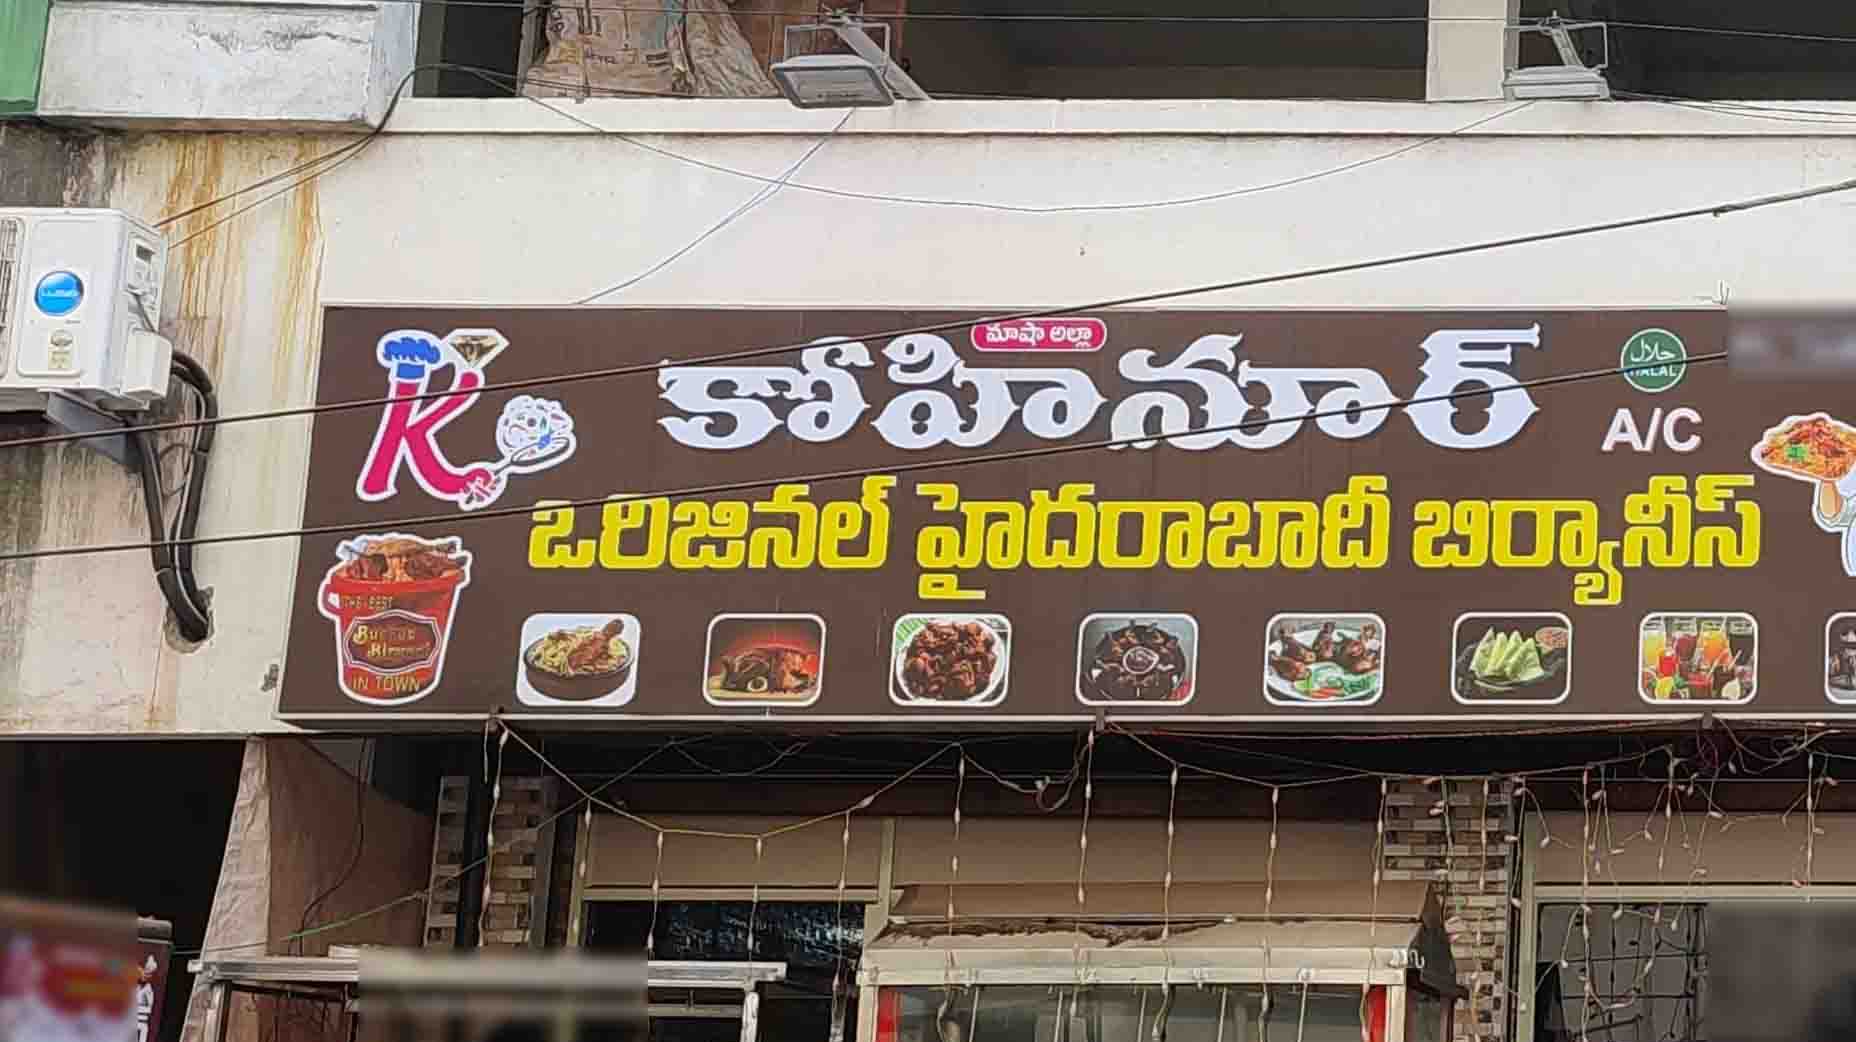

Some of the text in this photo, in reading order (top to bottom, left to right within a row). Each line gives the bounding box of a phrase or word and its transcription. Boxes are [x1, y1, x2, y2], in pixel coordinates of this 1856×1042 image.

[1630, 338, 1676, 362] حلال
[656, 322, 1541, 451] కోహినూర్
[1601, 407, 1702, 451] A/C
[527, 474, 898, 570] ఒరిజినల్
[915, 474, 1391, 601] హైదరాబాదీ
[375, 675, 420, 692] TOWN
